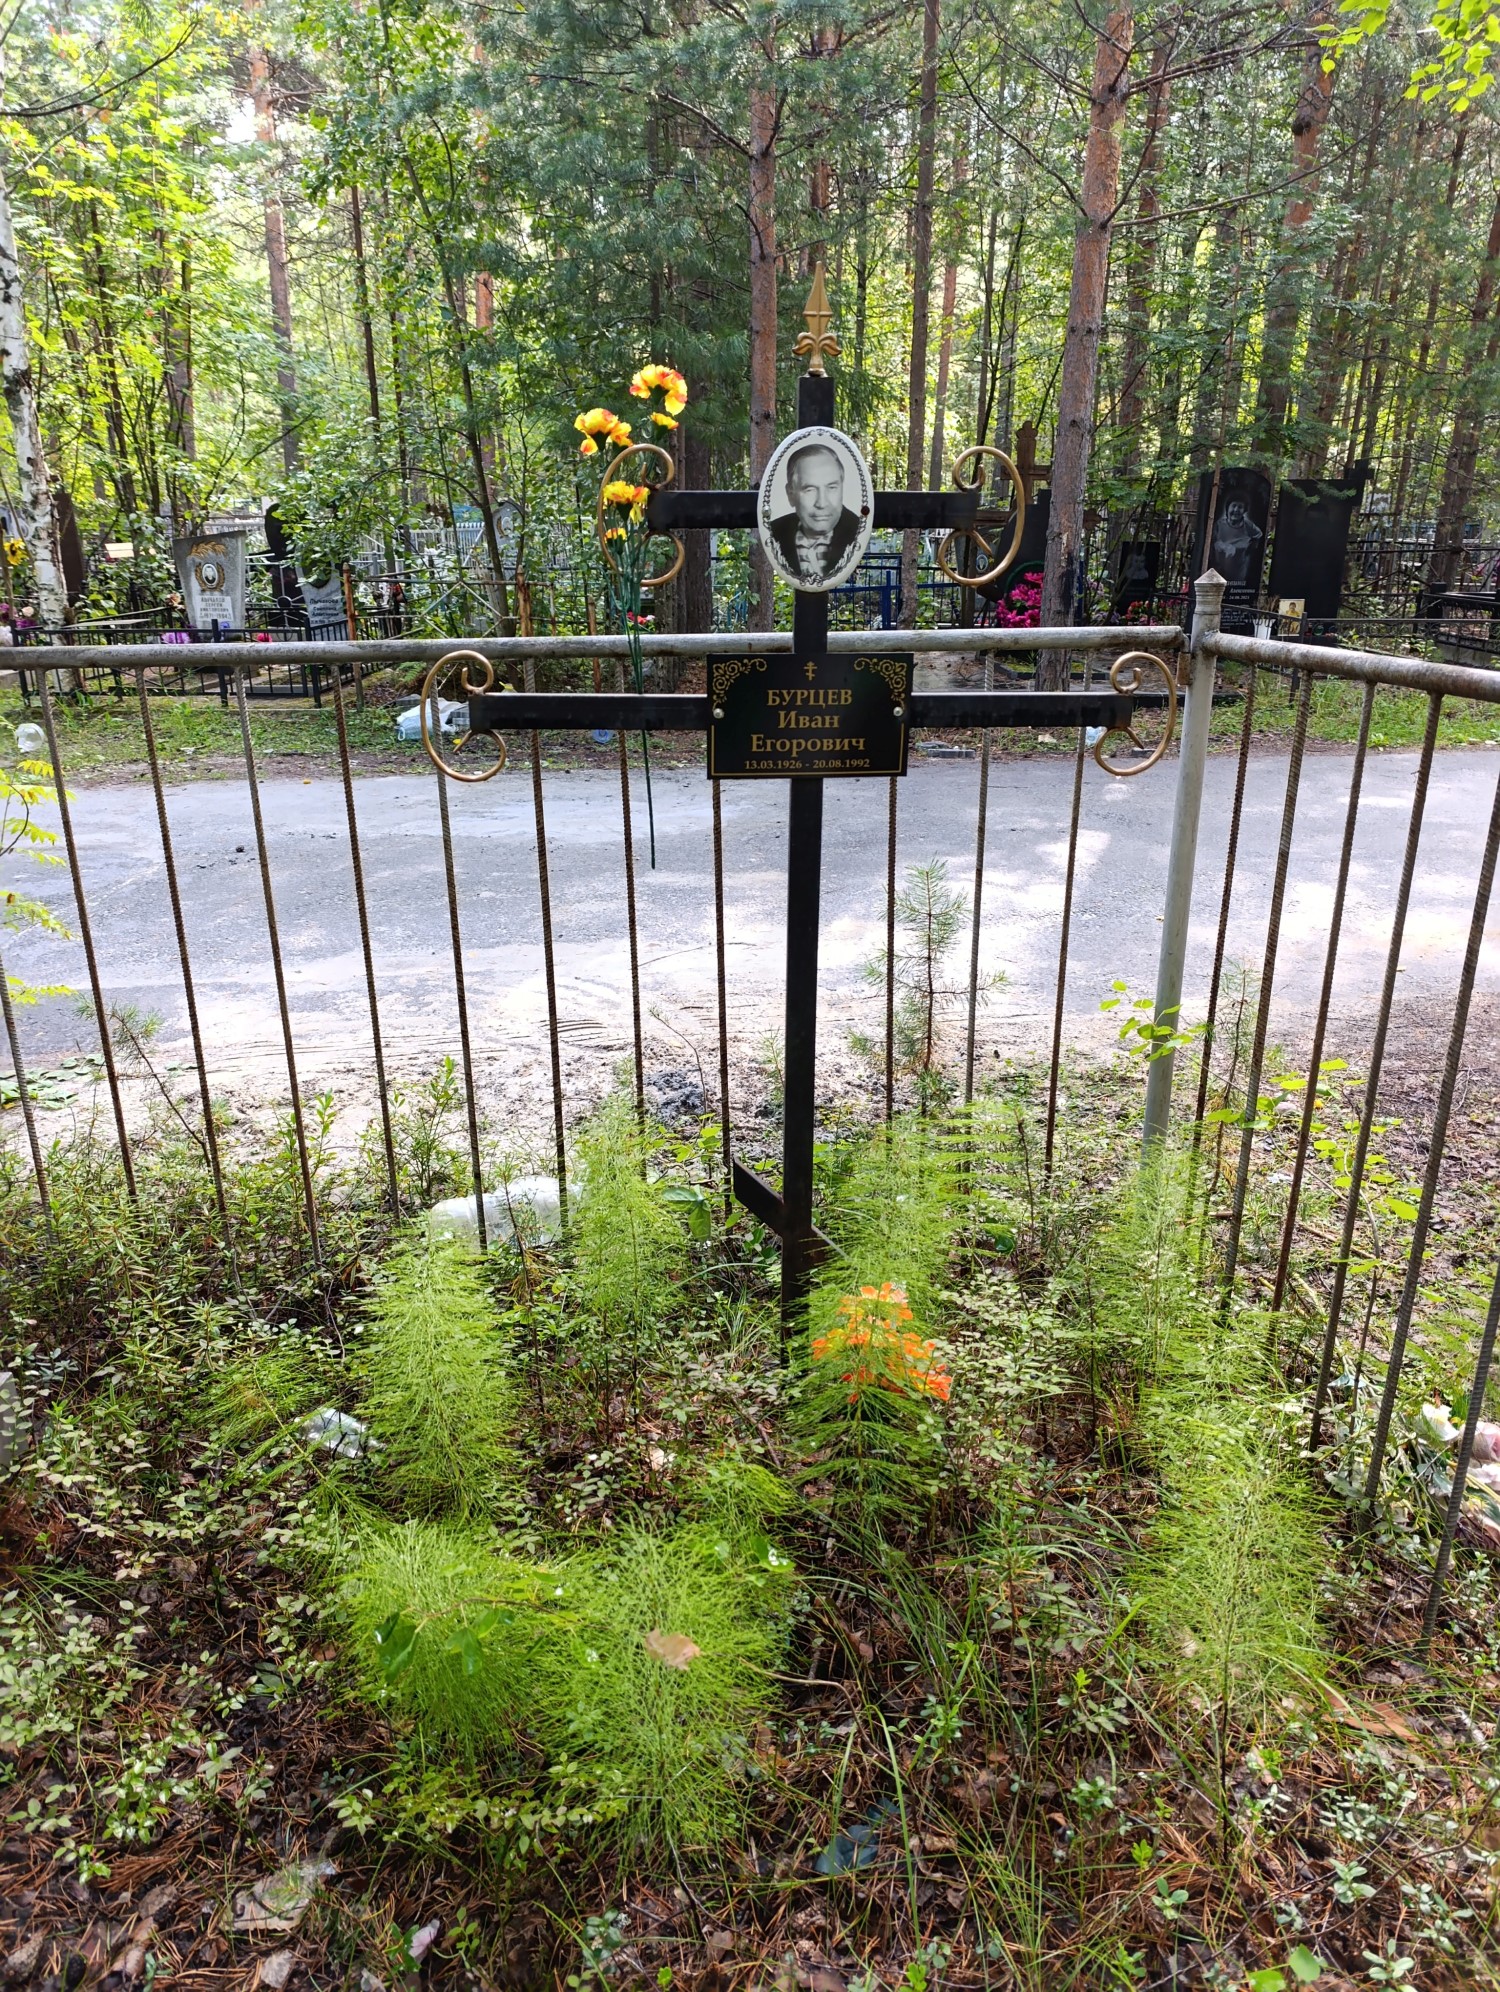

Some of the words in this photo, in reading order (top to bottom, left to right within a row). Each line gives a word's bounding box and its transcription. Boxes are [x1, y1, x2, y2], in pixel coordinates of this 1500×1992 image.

[767, 689, 852, 709] БУРЦЕВ
[778, 710, 840, 728] Иван
[751, 733, 866, 757] Егорович
[744, 760, 802, 769] 13.03.1926
[812, 759, 870, 768] 20.08.1992
